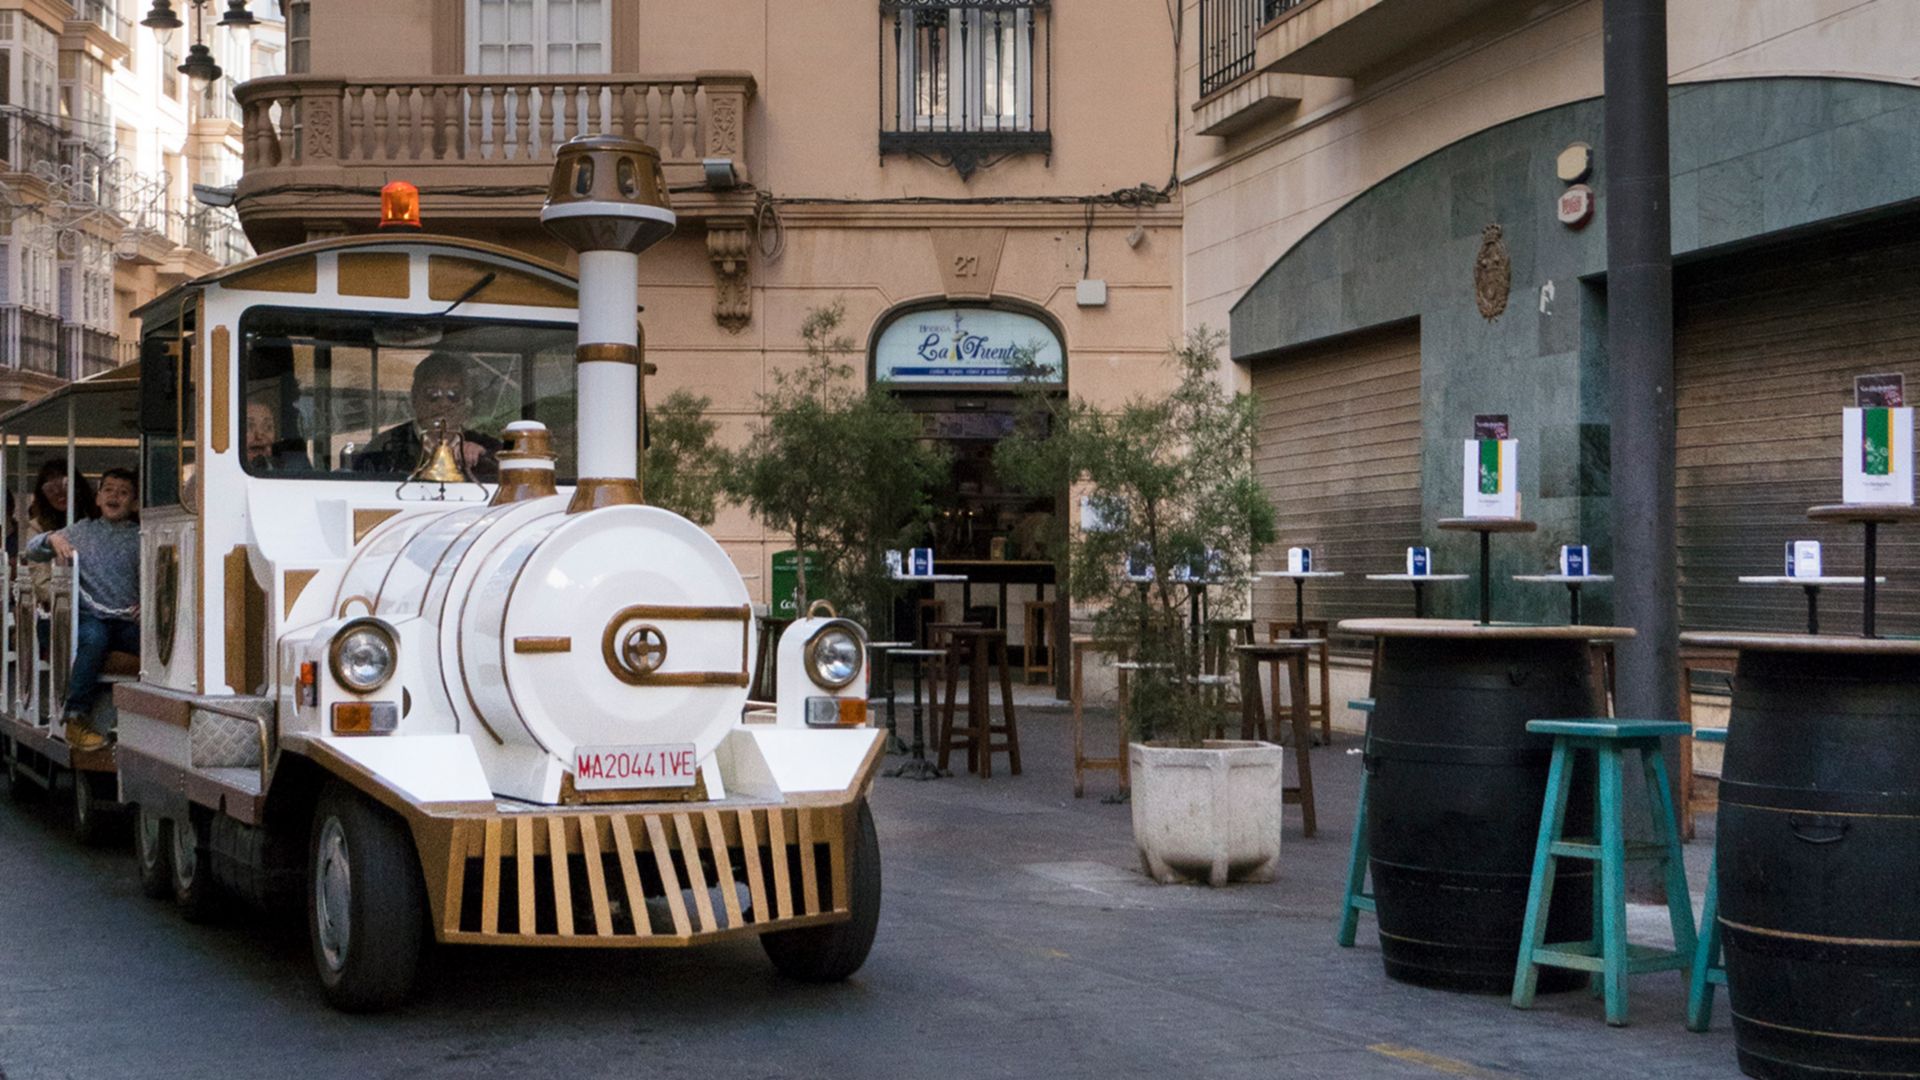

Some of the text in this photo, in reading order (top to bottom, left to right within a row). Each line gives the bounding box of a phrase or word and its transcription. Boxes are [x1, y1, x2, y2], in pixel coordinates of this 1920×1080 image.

[953, 255, 979, 277] 27
[917, 333, 949, 361] La
[577, 750, 694, 779] MA20441VE
